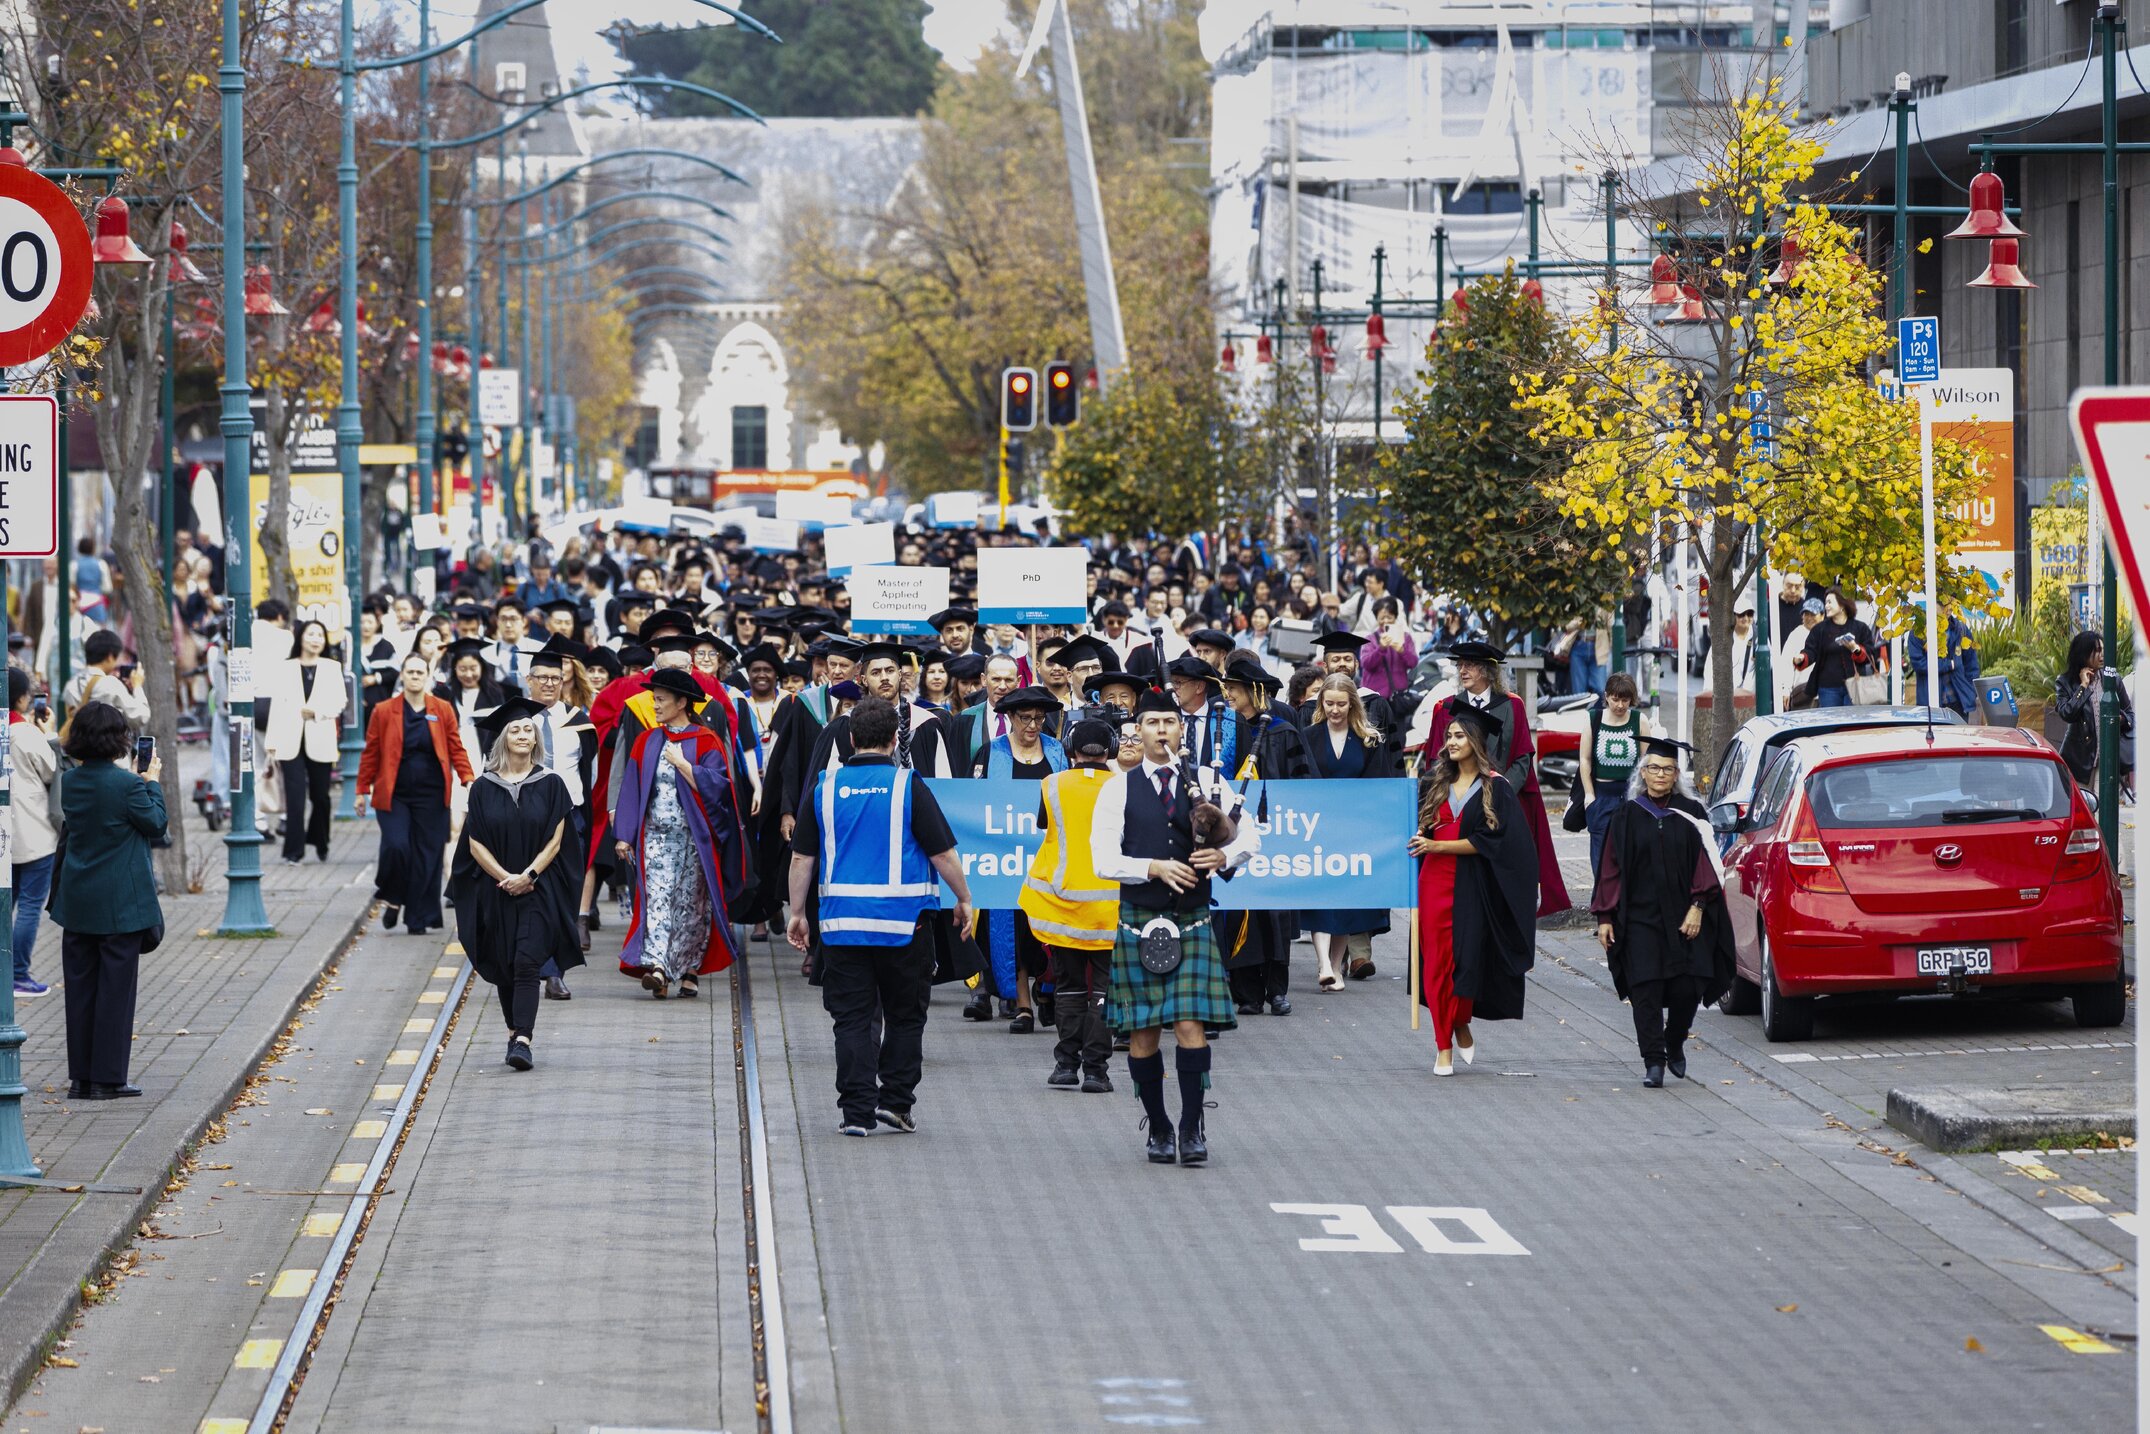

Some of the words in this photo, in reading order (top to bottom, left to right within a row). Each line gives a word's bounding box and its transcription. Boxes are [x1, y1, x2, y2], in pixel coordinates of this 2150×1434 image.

[2, 231, 47, 302] 0
[1910, 341, 1928, 356] 120
[1932, 387, 2000, 403] Wilson
[877, 579, 910, 587] Master
[913, 579, 923, 587] of
[1022, 574, 1041, 582] PhD
[881, 590, 919, 599] Applied
[872, 601, 927, 611] Computing
[1991, 690, 2001, 702] P
[985, 804, 1045, 835] Lin
[1255, 804, 1321, 842] sity
[1920, 951, 1988, 970] GRP50
[1270, 1202, 1532, 1256] 30
